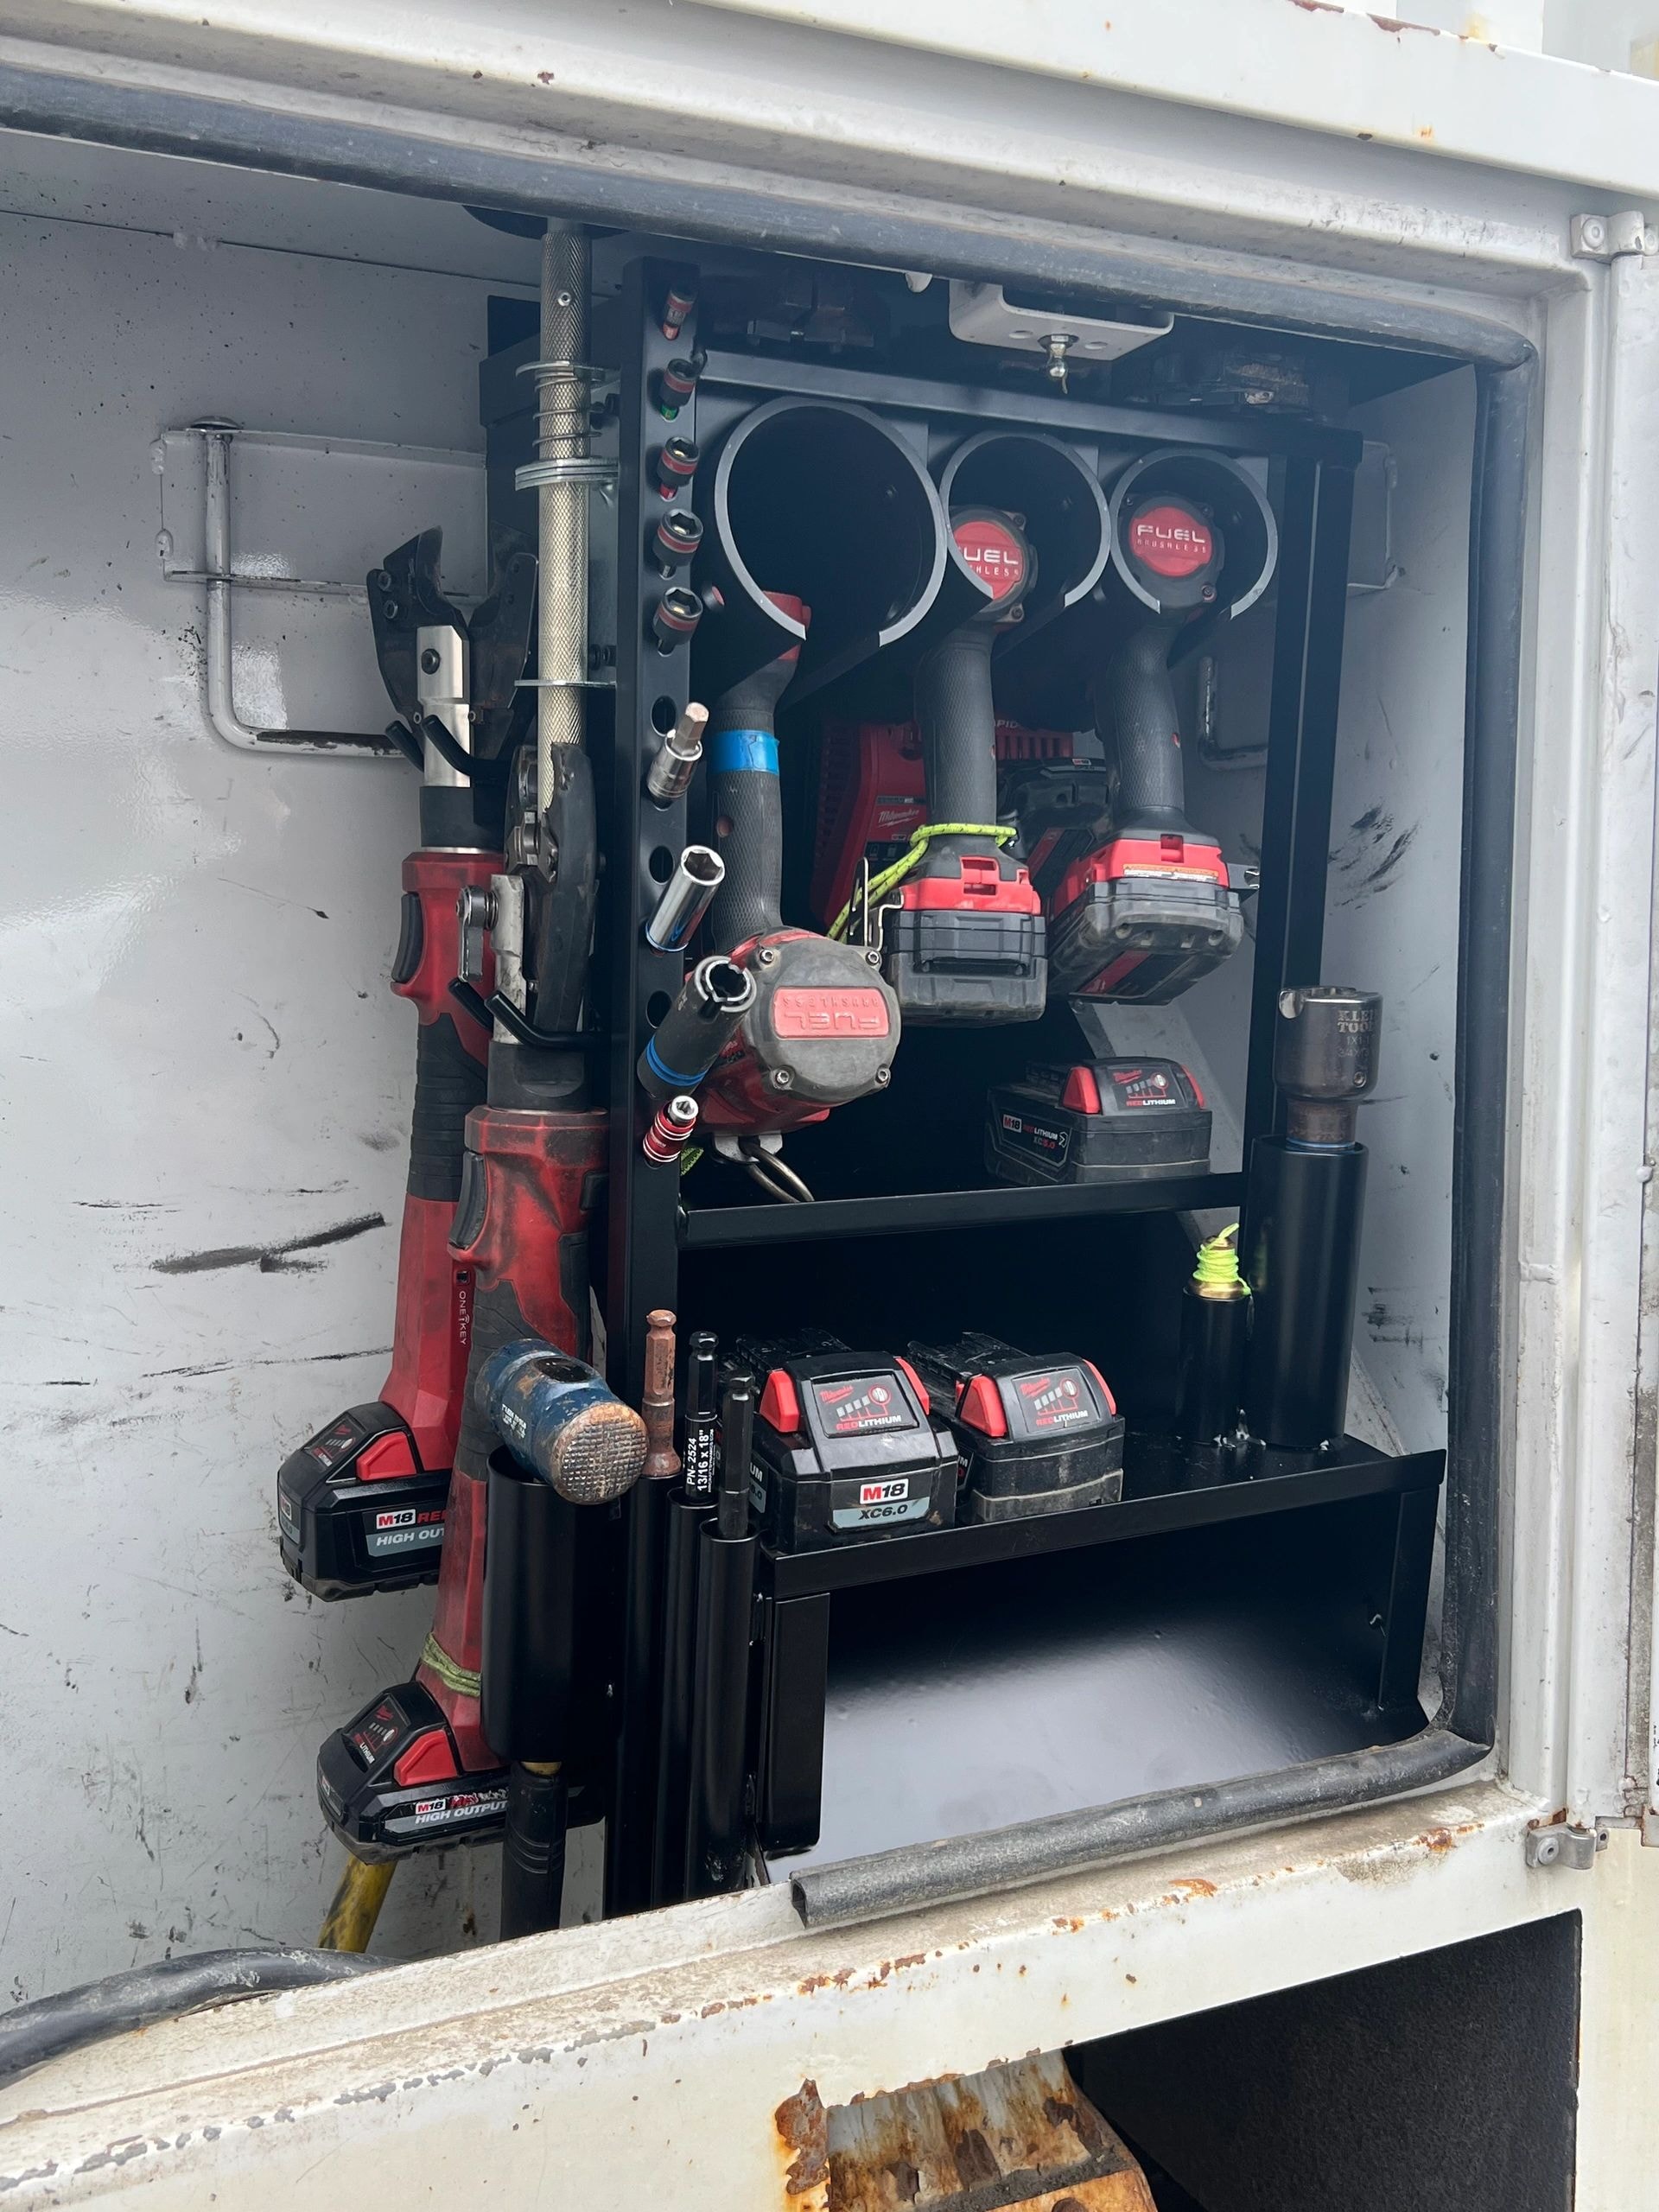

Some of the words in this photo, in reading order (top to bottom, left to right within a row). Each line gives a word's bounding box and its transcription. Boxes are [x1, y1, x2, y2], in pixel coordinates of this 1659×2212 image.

[1136, 524, 1205, 543] FUEL
[957, 545, 1019, 565] UEL
[783, 1011, 881, 1031] FUEL
[836, 1414, 902, 1431] REDLITHIUM
[698, 1429, 709, 1448] 18"
[687, 1437, 697, 1464] 2524
[696, 1460, 709, 1491] 13/16
[862, 1483, 906, 1501] M18
[378, 1511, 414, 1527] M18
[858, 1504, 908, 1521] XC6.0
[376, 1532, 415, 1547] HIGH
[416, 1811, 450, 1825] HIGH
[454, 1800, 508, 1817] OUTPUT
[417, 1801, 444, 1813] M18
